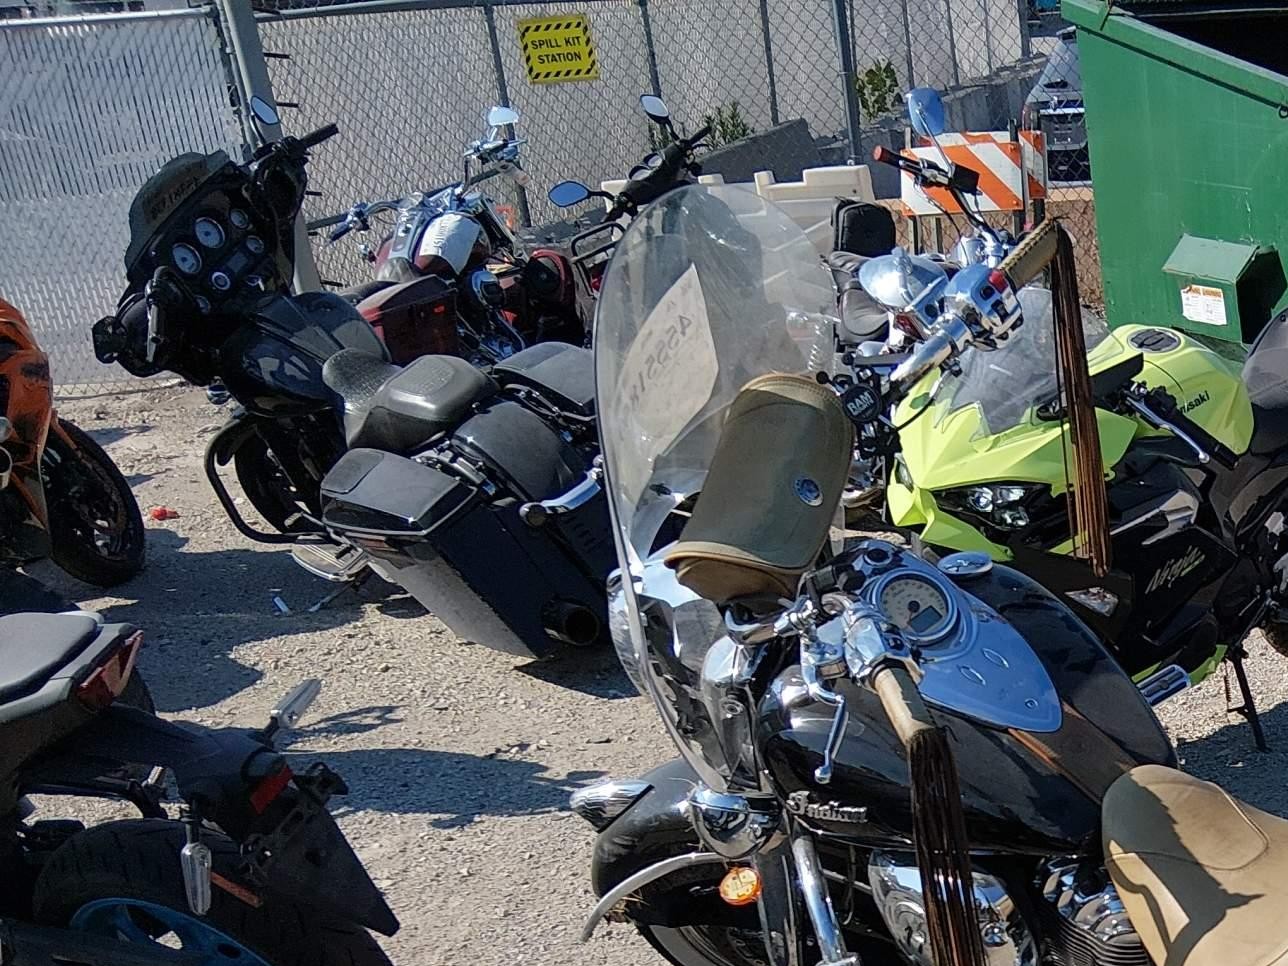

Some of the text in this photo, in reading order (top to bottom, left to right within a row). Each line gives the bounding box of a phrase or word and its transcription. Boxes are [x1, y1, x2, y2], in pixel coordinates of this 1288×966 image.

[530, 36, 582, 50] SPILL KIT
[537, 51, 582, 65] STATION
[847, 391, 875, 416] RAM
[1144, 544, 1202, 595] Ninja
[785, 790, 869, 824] Indian
